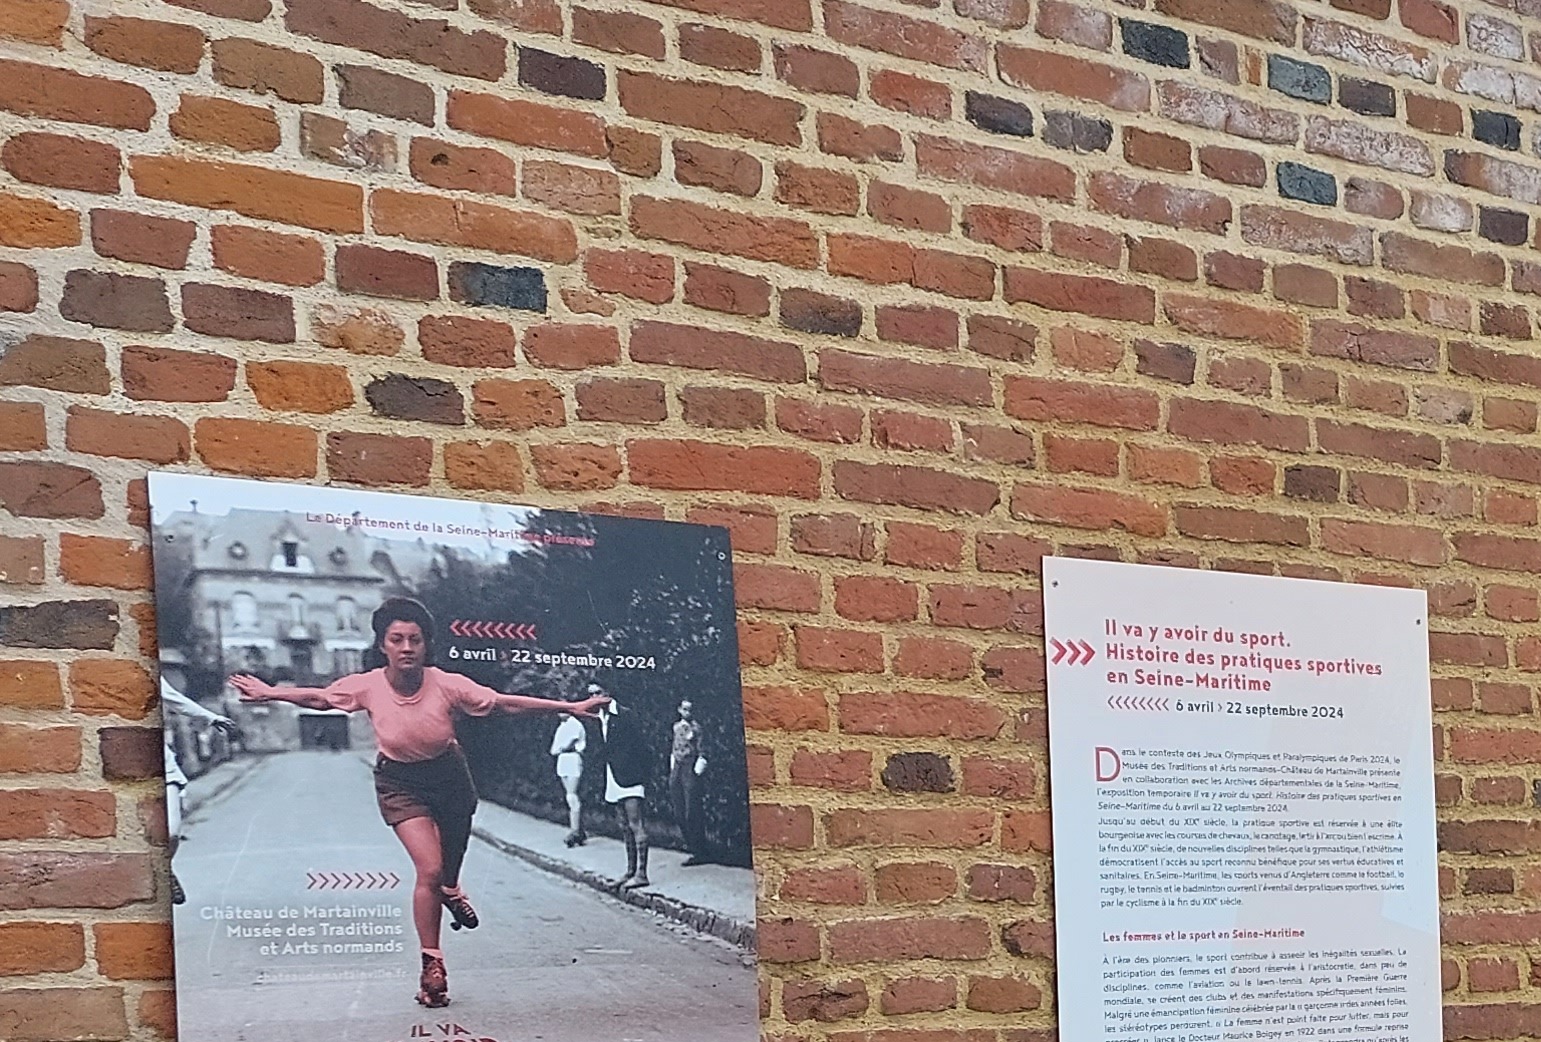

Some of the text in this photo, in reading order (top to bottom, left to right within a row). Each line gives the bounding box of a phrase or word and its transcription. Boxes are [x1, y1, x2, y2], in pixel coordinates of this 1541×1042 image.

[306, 512, 322, 522] Le
[325, 513, 410, 532] Département
[414, 520, 429, 532] de
[432, 522, 444, 534] la
[1106, 618, 1292, 648] Il va y avoir du sport.
[449, 646, 655, 668] 6 avril 22 septembre 2024
[1106, 643, 1381, 675] Histoire des pratiques sportives
[1107, 669, 1270, 690] en Seine-Maritime
[1176, 700, 1342, 718] 6 avril 22 septembre 2024
[201, 904, 400, 919] Château de Martainville
[228, 922, 401, 937] Musée des Traditions
[1103, 932, 1120, 942] Les
[1123, 931, 1161, 941] femmes
[1164, 930, 1174, 940] et
[1178, 930, 1186, 940] le
[1190, 930, 1215, 942] sport
[1232, 928, 1304, 938] Seine-Maritime
[260, 940, 402, 955] et Arts normands
[410, 1022, 472, 1038] IL VA
